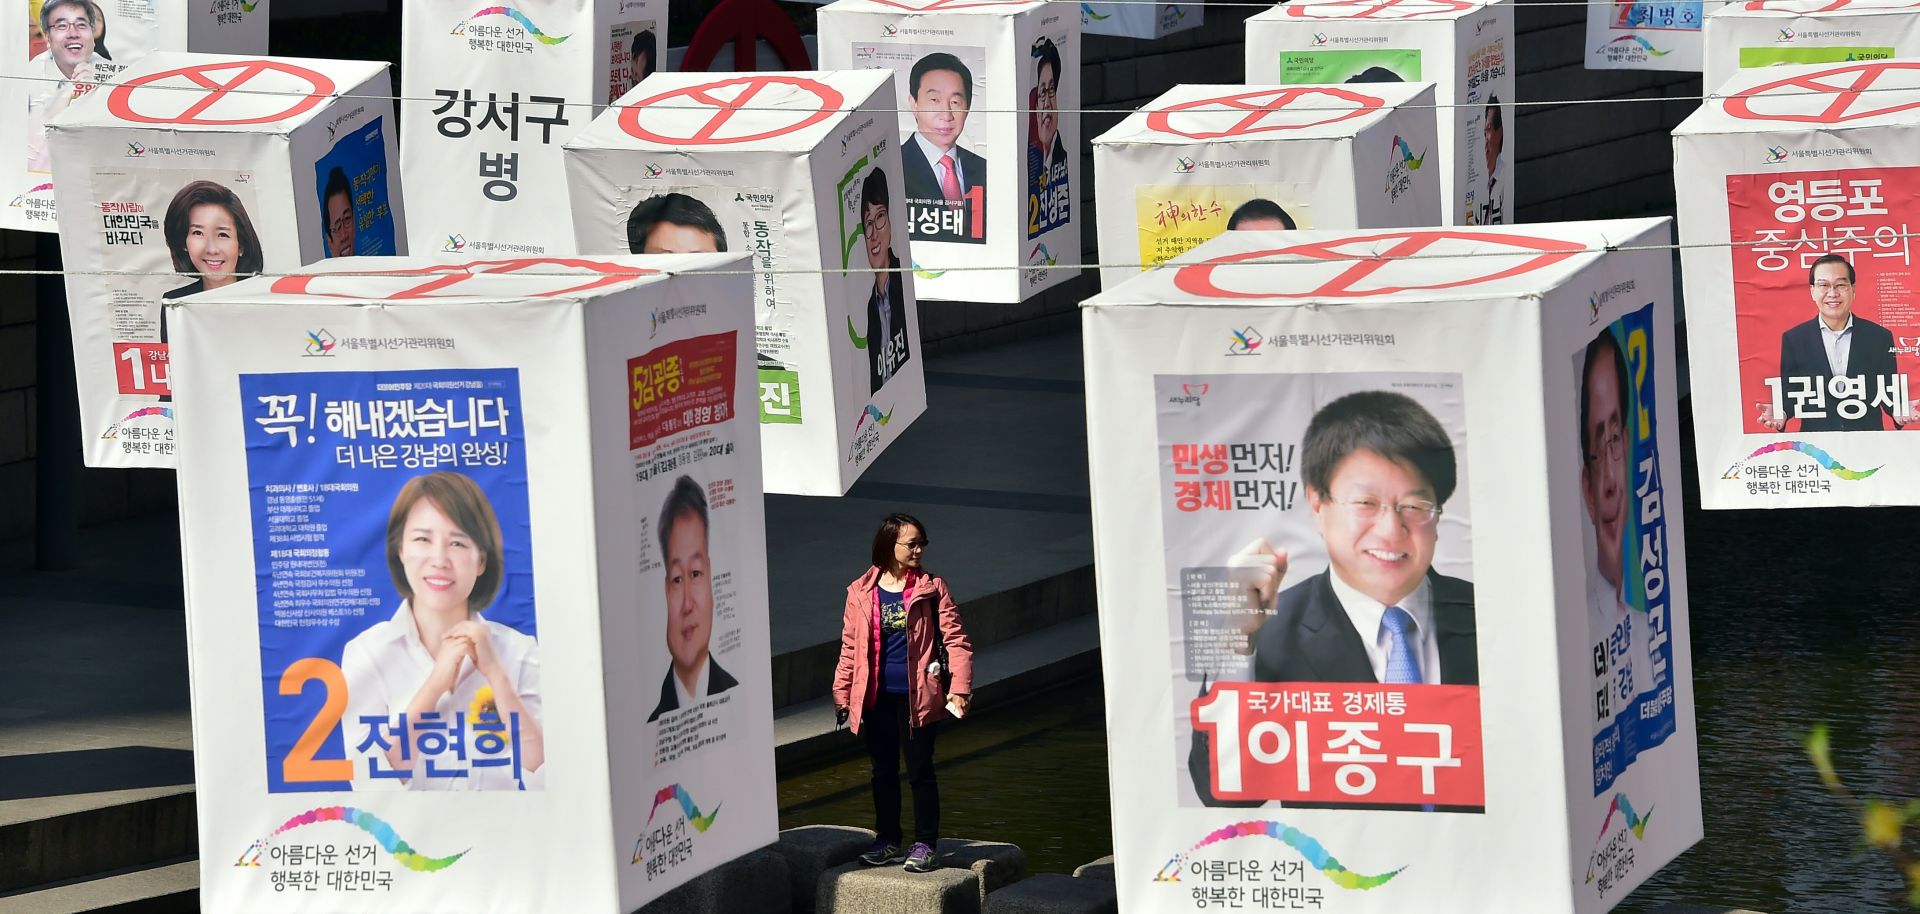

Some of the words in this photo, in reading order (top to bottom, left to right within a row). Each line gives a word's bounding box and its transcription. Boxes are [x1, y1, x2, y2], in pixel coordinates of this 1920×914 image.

[1639, 6, 1698, 26] 최병호
[469, 25, 502, 38] 아름다운
[506, 26, 524, 40] 선거
[900, 28, 954, 36] 서울특별시선거관리위원회
[1798, 30, 1861, 38] 서울특별시선거관리위원회
[469, 39, 494, 50] 행복한
[497, 42, 534, 54] 대한민국
[1329, 35, 1388, 44] 서울특별시선거관리위원회
[94, 64, 116, 72] 박근혜
[432, 89, 569, 144] 강서구
[148, 148, 216, 156] 서울특별시선거관리위원회
[1792, 147, 1872, 158] 서울특별시선거관리위원회
[1198, 158, 1270, 168] 서울특별시선거관리위원회
[479, 152, 519, 202] 병
[666, 168, 734, 176] 서울특별시선거관리위원회
[746, 194, 774, 202] 국민의당
[1768, 179, 1888, 222] 영등포
[101, 202, 144, 213] 동작사람이
[964, 186, 984, 238] 1
[1028, 194, 1040, 234] 2
[1040, 183, 1069, 228] 진성준
[26, 210, 48, 221] 행복한
[104, 215, 158, 229] 대한민국을
[106, 232, 143, 244] 바꾸다
[1156, 237, 1168, 245] 선거
[470, 241, 545, 254] 서울특별시선거관리위원회
[1752, 224, 1910, 271] 중심주의
[341, 336, 456, 350] 서울특별시선거관리위원회
[1268, 334, 1395, 348] 서울특별시선거관리위원회
[878, 328, 906, 377] 이유진
[1888, 346, 1920, 356] 새누리당
[121, 348, 145, 390] 1
[1628, 328, 1650, 442] 2
[760, 382, 790, 415] 진
[1168, 396, 1200, 406] 새누리당
[256, 392, 317, 448] 꼭!
[324, 396, 509, 440] 해내겠습니다
[122, 428, 160, 440] 아름다운
[122, 442, 150, 454] 행복한
[336, 445, 355, 468] 더
[358, 444, 398, 468] 나은
[400, 443, 457, 468] 강남의
[462, 442, 508, 468] 완성!
[1745, 465, 1792, 478] 아름다운
[1796, 464, 1819, 478] 선거
[1746, 480, 1780, 494] 행복한
[1786, 480, 1832, 494] 대한민국
[1636, 449, 1668, 678] 김성곤
[1247, 691, 1334, 714] 국가대표
[1342, 692, 1407, 715] 경제통
[278, 657, 354, 783] 2
[356, 712, 522, 780] 전현희
[1198, 690, 1242, 792] 1
[1248, 720, 1462, 796] 이종구
[270, 844, 338, 866] 아름다운
[345, 844, 376, 866] 선거
[1190, 860, 1263, 882] 아름다운
[1270, 859, 1304, 882] 선거
[270, 870, 320, 892] 행복한
[326, 870, 393, 891] 대한민국
[1192, 886, 1245, 908] 행복한
[1252, 887, 1324, 910] 대한민국
